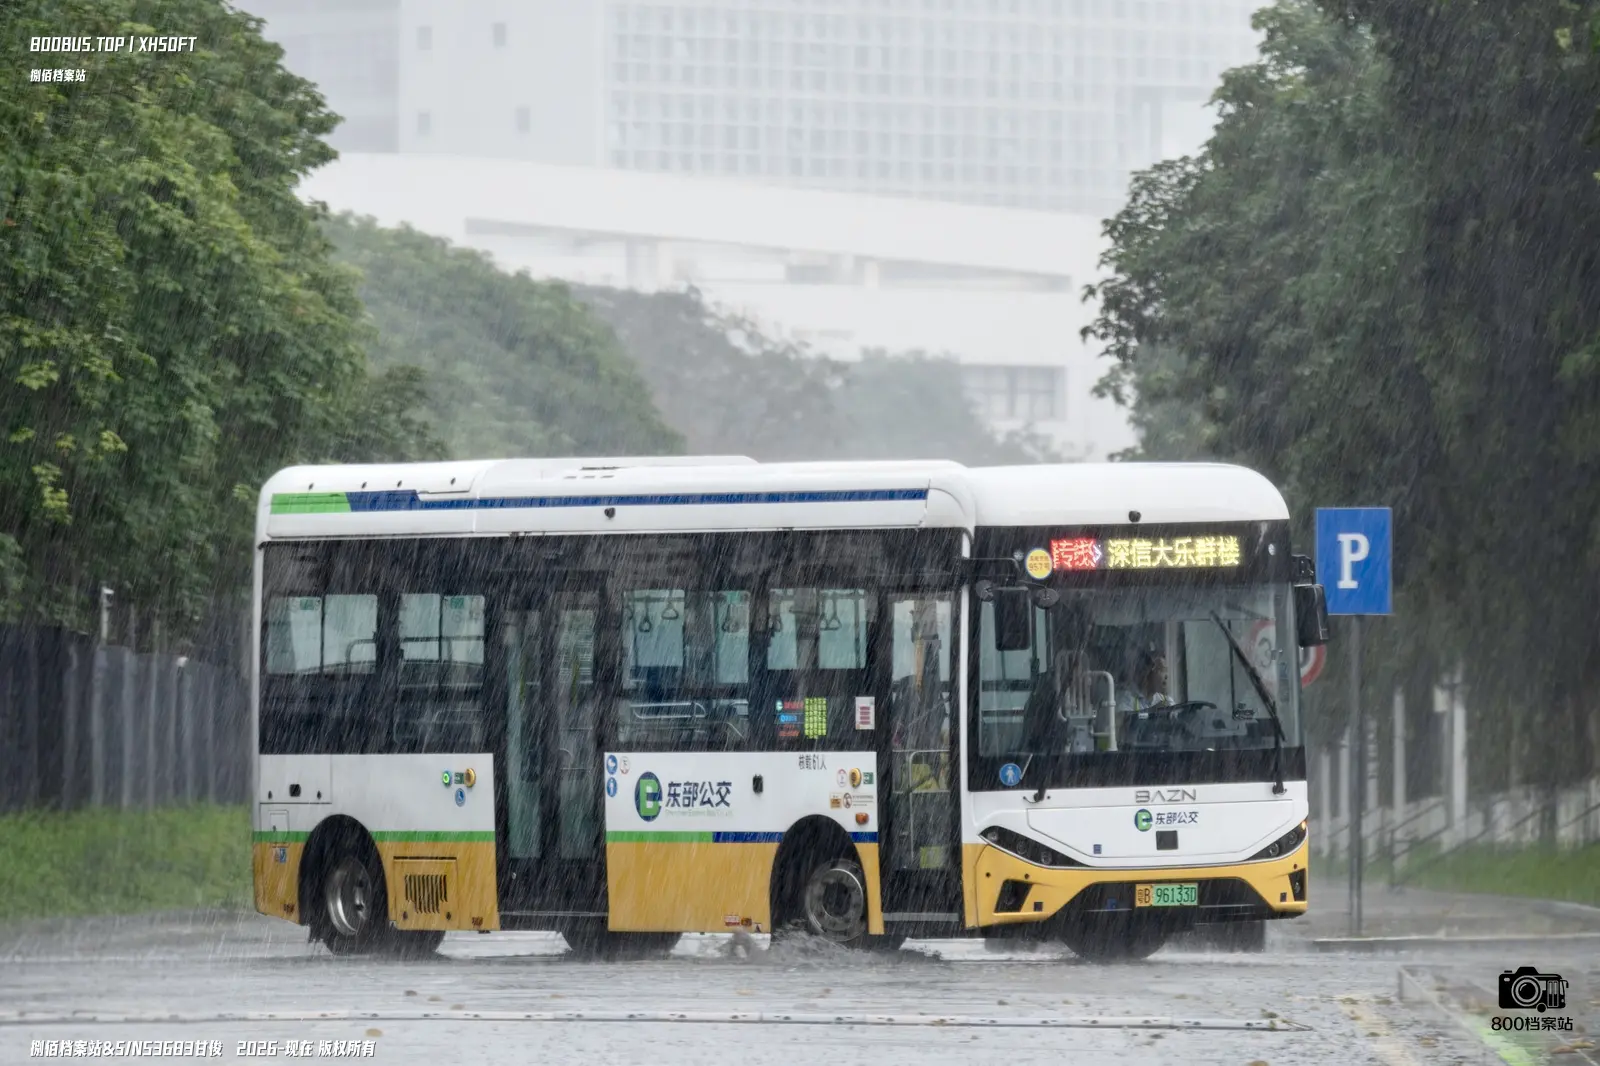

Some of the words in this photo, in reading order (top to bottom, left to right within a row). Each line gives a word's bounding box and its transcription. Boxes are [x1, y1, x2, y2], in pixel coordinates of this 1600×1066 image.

[1108, 536, 1240, 567] 深信大乐群楼
[1337, 533, 1370, 589] P
[665, 781, 732, 808] 东部公交
[1135, 789, 1197, 803] BAZN
[1155, 811, 1199, 825] 东部公交
